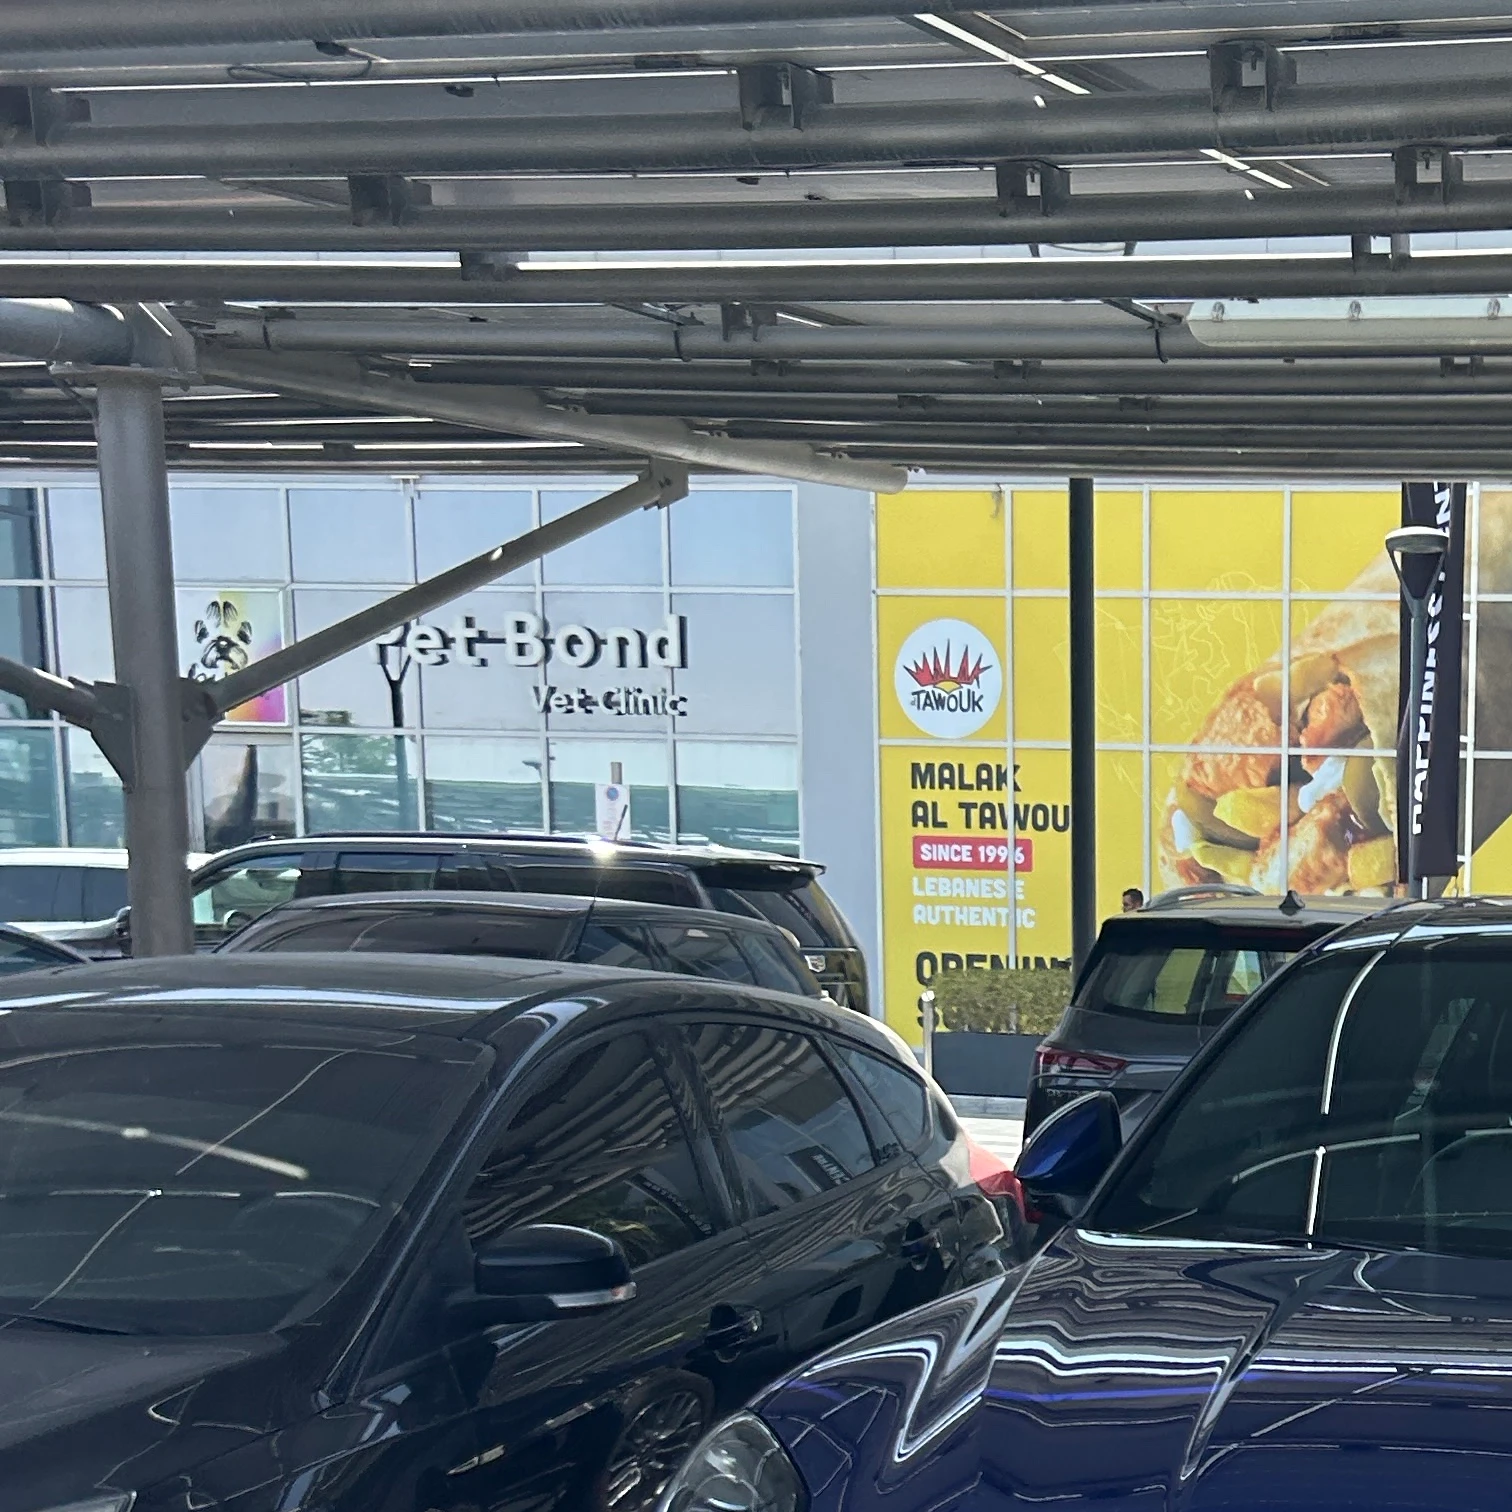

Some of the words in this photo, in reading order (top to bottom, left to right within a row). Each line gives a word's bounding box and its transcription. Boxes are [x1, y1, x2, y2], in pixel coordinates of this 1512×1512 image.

[505, 610, 681, 668] Bond
[531, 686, 588, 715] Vet
[600, 687, 687, 717] Clinic
[911, 689, 984, 713] TAWOUK
[911, 763, 1021, 792] MALAK
[912, 800, 948, 828] AL
[958, 802, 1071, 832] TAWOU
[920, 843, 973, 862] SINCE
[978, 845, 1025, 864] 1996
[912, 876, 1025, 900] LEBANESE
[913, 904, 1036, 929] AUTHENTIC
